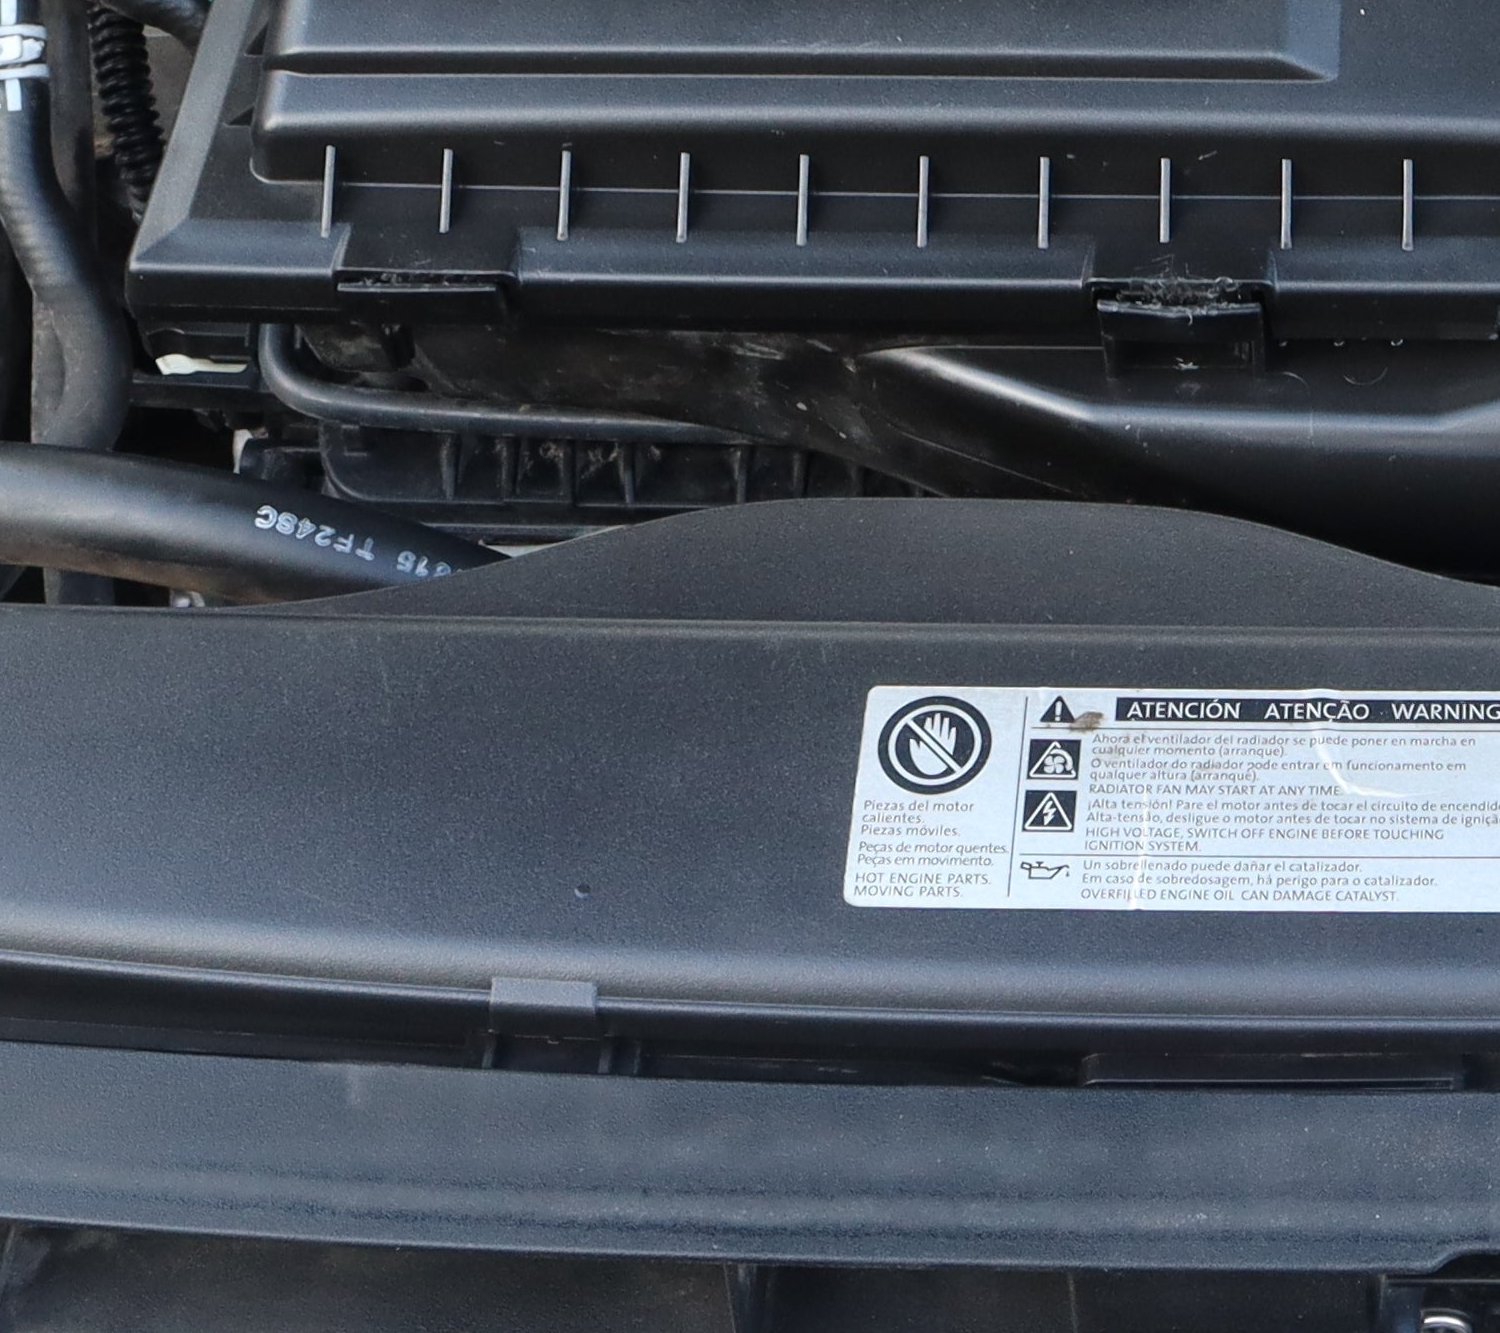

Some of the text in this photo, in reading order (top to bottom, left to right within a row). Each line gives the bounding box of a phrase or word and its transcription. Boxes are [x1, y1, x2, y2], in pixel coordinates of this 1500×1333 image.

[1127, 699, 1242, 720] ATENCIÓN
[1264, 700, 1369, 722] ATENÇÃO
[1092, 734, 1130, 744] Ahora
[1149, 735, 1211, 745] ventilador
[1214, 735, 1233, 745] del
[1237, 735, 1290, 745] radiador
[1293, 738, 1307, 746] se
[1309, 736, 1349, 747] puede
[1351, 738, 1388, 747] poner
[1391, 738, 1406, 746] en
[1410, 736, 1457, 746] marcha
[1460, 738, 1476, 746] en
[1092, 745, 1149, 757] cualquier
[1154, 746, 1216, 756] momento
[1091, 759, 1101, 769] O
[1104, 759, 1168, 769] ventilador
[1171, 759, 1187, 769] do
[1191, 760, 1243, 770] radiador
[1247, 760, 1279, 773] pode
[1282, 761, 1319, 770] entrar
[1347, 760, 1443, 771] funcionamento
[1447, 762, 1466, 771] em
[1090, 771, 1147, 782] qualquer
[1150, 771, 1187, 780] altura
[1089, 785, 1153, 795] RADIATOR
[1156, 785, 1181, 795] FAN
[1185, 785, 1215, 795] MAY
[1218, 786, 1255, 795] START
[1259, 786, 1274, 795] AT
[1278, 786, 1305, 796] ANY
[863, 800, 974, 812] Piezas del motor
[1087, 799, 1117, 810] ¡Alta
[1176, 800, 1203, 810] Pare
[1207, 800, 1217, 810] el
[1221, 801, 1260, 811] motor
[1264, 802, 1298, 811] antes
[1301, 801, 1317, 811] de
[1321, 802, 1353, 812] tocar
[1356, 801, 1367, 812] el
[1371, 801, 1418, 812] circuito
[1421, 801, 1436, 812] de
[862, 812, 925, 824] calientes.
[1166, 813, 1219, 826] desligue
[1223, 816, 1231, 824] o
[1234, 815, 1273, 824] motor
[1276, 815, 1311, 824] antes
[1314, 814, 1330, 825] de
[1334, 814, 1366, 824] tocar
[1370, 816, 1386, 824] no
[1389, 815, 1438, 825] sistema
[1442, 814, 1458, 825] de
[861, 824, 960, 836] Piezas móviles.
[1086, 827, 1444, 840] HIGH VOLTAGE, SWITCH OFF ENGINE BEFORE TOUCHING
[859, 841, 1010, 856] Peças de motor quentes.
[1084, 840, 1144, 850] IGNITION
[857, 854, 994, 867] Peças em movimento.
[1084, 859, 1362, 873] Un sobrellenado puede dañar el catalizador.
[855, 872, 991, 885] HOT ENGINE PARTS.
[1082, 874, 1438, 888] Em caso de sobredosagem, há perigo para o catalizador.
[853, 886, 963, 897] MOVING PARTS.
[1160, 889, 1210, 900] ENGINE
[1213, 890, 1235, 901] OIL
[1241, 890, 1269, 901] CAN
[1273, 890, 1331, 901] DAMAGE
